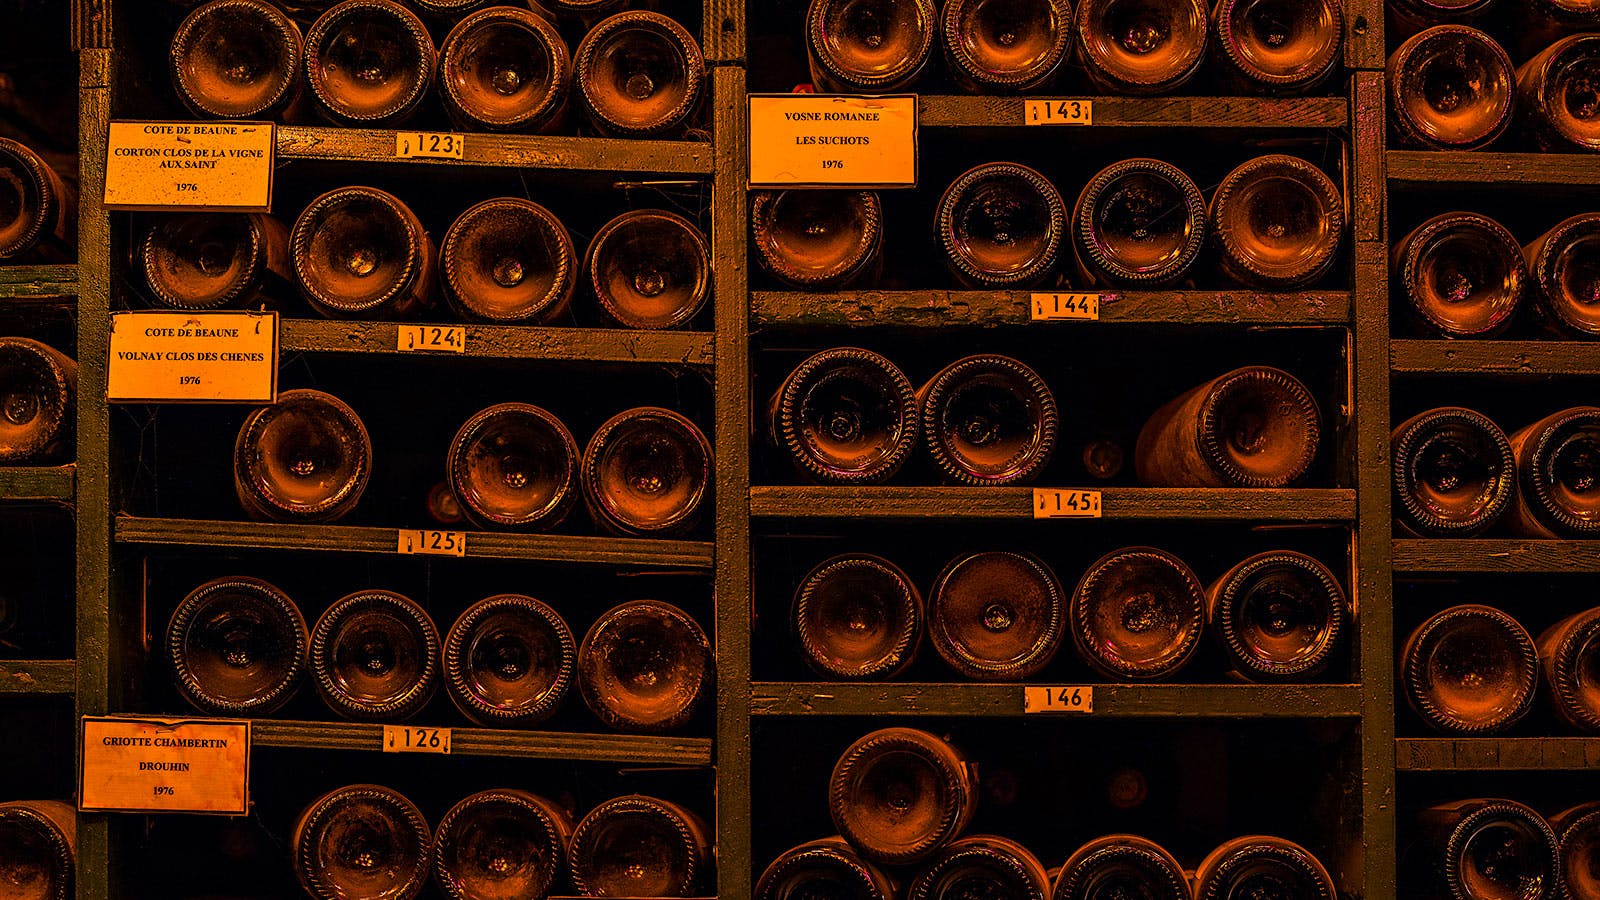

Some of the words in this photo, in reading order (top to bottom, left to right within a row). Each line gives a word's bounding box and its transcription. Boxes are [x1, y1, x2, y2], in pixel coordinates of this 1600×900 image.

[1045, 102, 1081, 119] 143
[785, 112, 822, 121] VOSNE
[824, 112, 880, 121] ROMANEE
[143, 125, 174, 134] COTE
[177, 126, 191, 134] DE
[193, 126, 238, 135] BEAUNE
[418, 135, 453, 153] 123
[795, 136, 816, 145] LES
[818, 136, 870, 145] SUCHOTS
[114, 148, 161, 157] CORTON
[163, 148, 192, 157] CLOS
[194, 149, 210, 157] DE
[212, 149, 226, 158] LA
[229, 149, 264, 158] VIGNE
[159, 160, 182, 169] AUX
[184, 160, 218, 169] SAINT
[822, 160, 843, 168] 1976
[176, 183, 198, 191] 1976
[1053, 295, 1088, 313] 144
[145, 328, 175, 337] COTE
[177, 328, 192, 337] DE
[195, 328, 239, 337] BEAUNE
[420, 327, 455, 346] 124
[117, 352, 164, 361] VOLNAY
[165, 352, 195, 361] CLOS
[197, 352, 218, 361] DES
[220, 352, 264, 361] CHENES
[179, 376, 201, 385] 1976
[1055, 493, 1091, 511] 145
[419, 531, 455, 550] 125
[1046, 688, 1082, 706] 146
[102, 737, 152, 746] GRIOTTE
[153, 738, 228, 748] CHAMBERTIN
[405, 729, 440, 748] 126
[139, 762, 190, 771] DROUHIN
[153, 786, 174, 795] 1976
